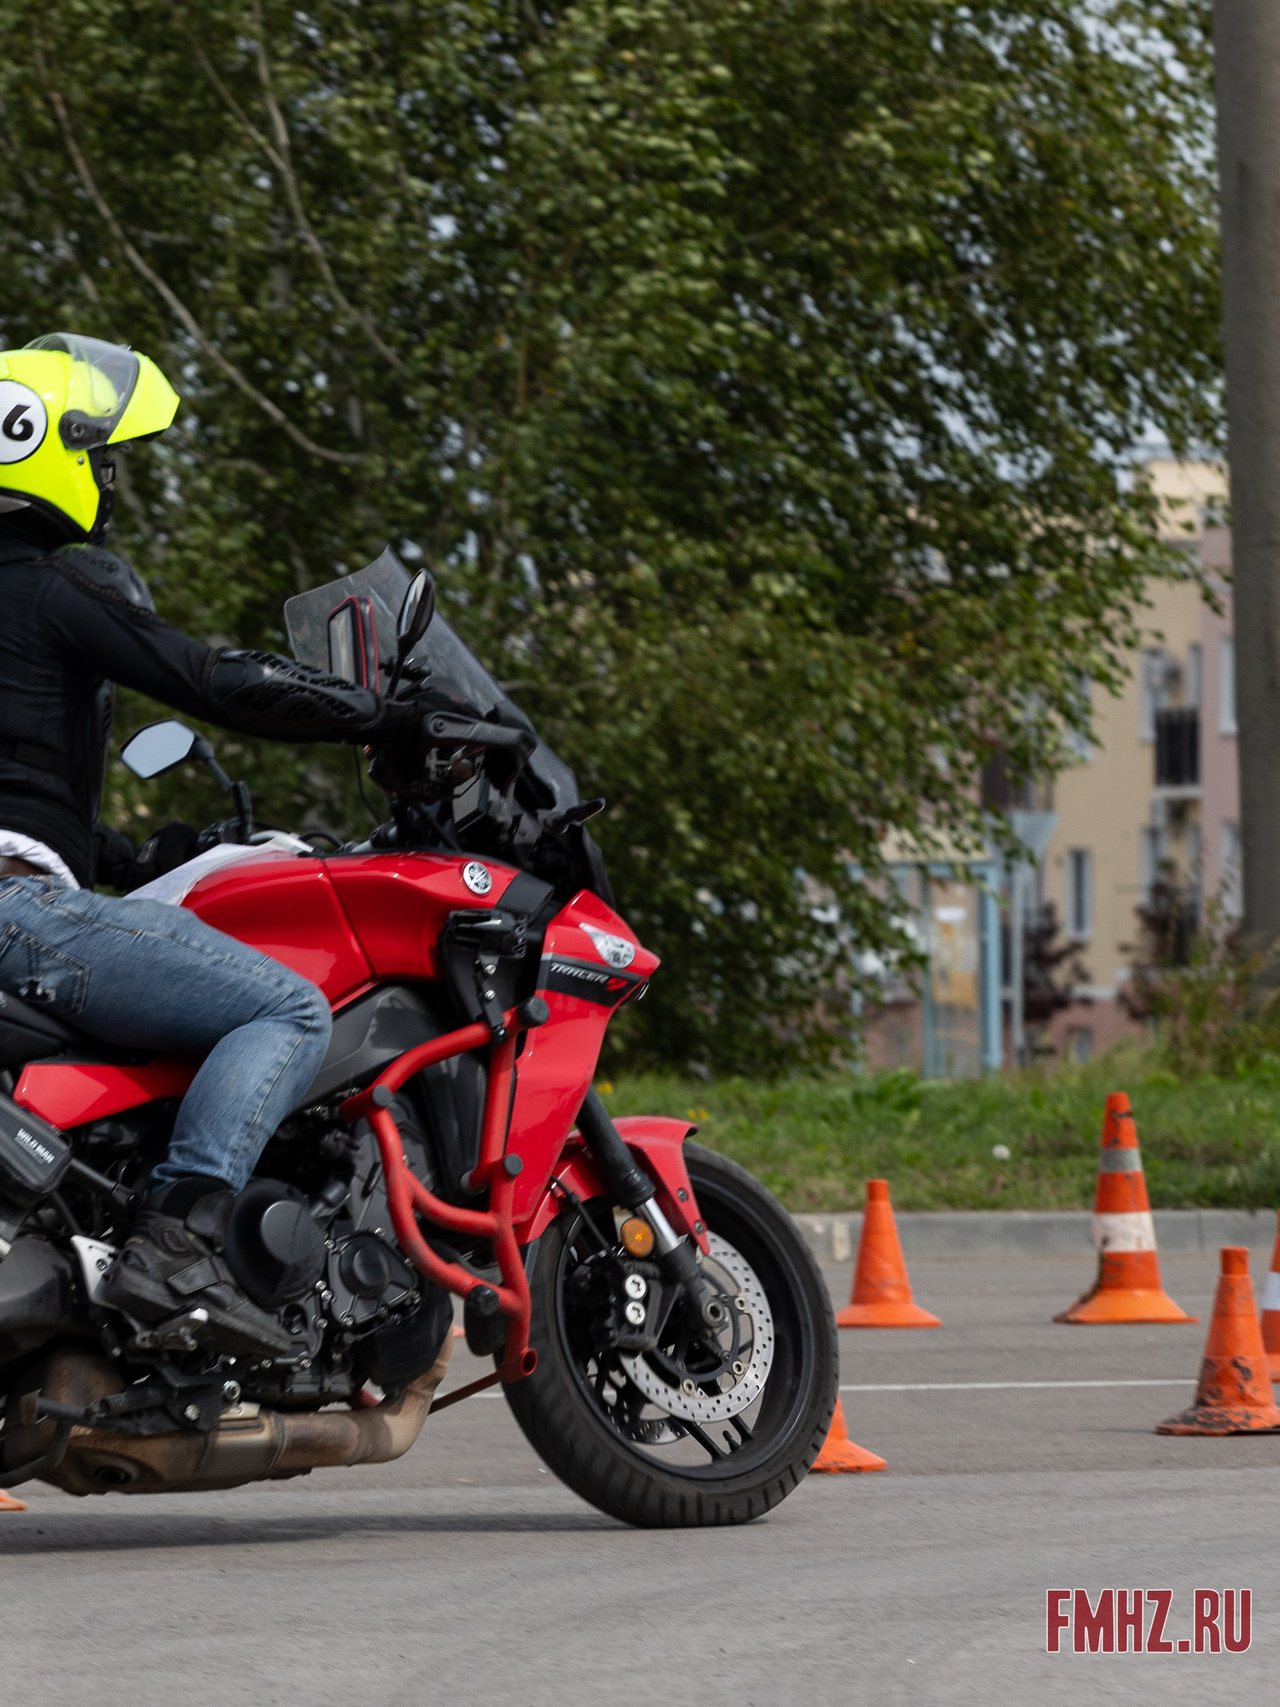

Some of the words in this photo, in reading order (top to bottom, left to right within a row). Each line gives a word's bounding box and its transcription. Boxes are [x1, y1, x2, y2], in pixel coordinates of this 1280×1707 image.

[550, 962, 610, 984] TRACER
[16, 1127, 39, 1150] WILD
[34, 1144, 55, 1164] MAN
